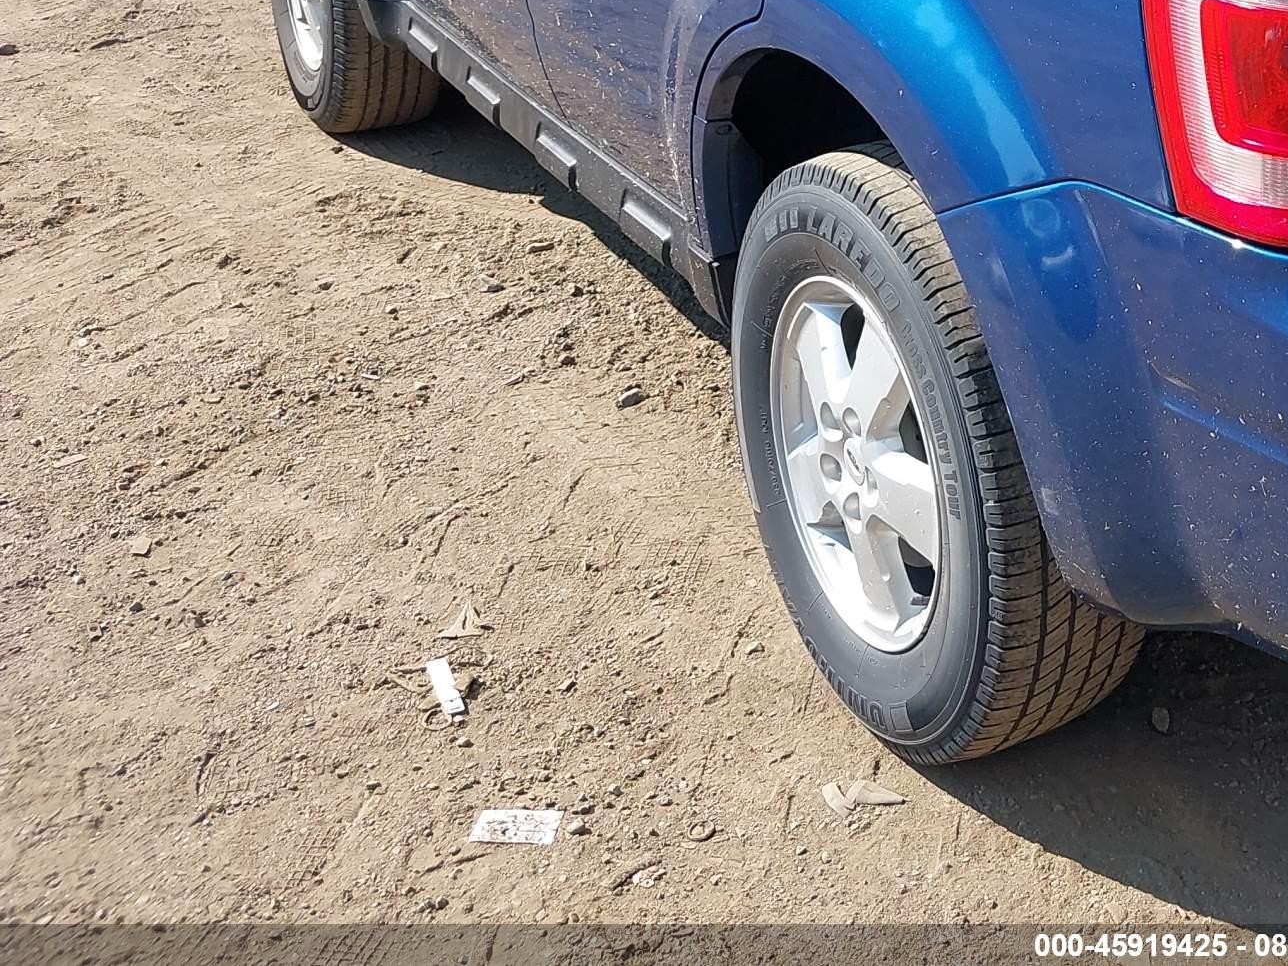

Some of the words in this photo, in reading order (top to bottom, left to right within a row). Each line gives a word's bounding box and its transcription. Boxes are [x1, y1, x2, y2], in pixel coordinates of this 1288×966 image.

[806, 205, 902, 314] LAREDO
[899, 320, 928, 381] Cross
[921, 381, 953, 466] Country
[943, 469, 963, 522] Tour
